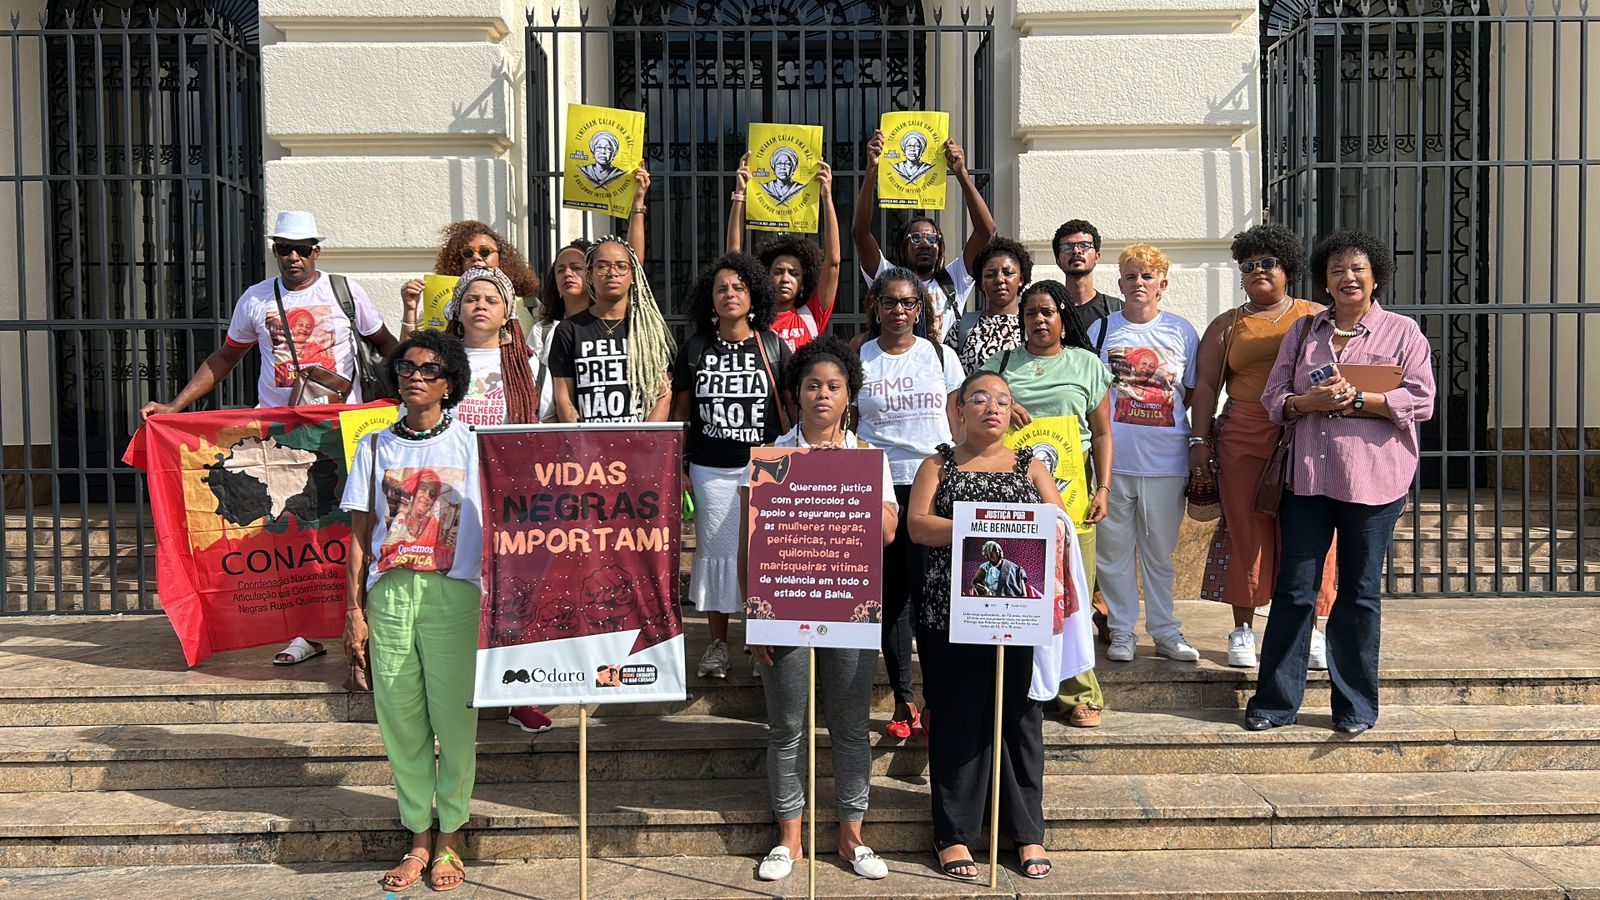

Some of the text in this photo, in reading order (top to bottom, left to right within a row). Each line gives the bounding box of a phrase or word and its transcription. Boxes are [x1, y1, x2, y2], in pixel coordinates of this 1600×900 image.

[705, 353, 756, 371] PELE
[576, 359, 628, 384] PRET
[697, 372, 767, 394] PRETA
[578, 386, 625, 418] NÃO
[879, 393, 943, 413] JUNTAS
[459, 405, 504, 414] MULHERES
[699, 398, 765, 428] NÃO É
[459, 414, 504, 425] NEGRAS
[534, 461, 627, 487] VIDAS
[789, 482, 872, 494] Queremos justiça
[503, 491, 659, 524] NEGRAS
[771, 496, 860, 506] com protocolos de
[760, 509, 871, 520] apoio e segurança para
[984, 510, 1011, 520] JUSTIÇA
[764, 522, 866, 534] as mulheres negras,
[971, 521, 1039, 534] MÃE BERNADETE!
[493, 527, 670, 556] IMPORTAM!
[767, 534, 863, 547] periféricas, rurais,
[221, 540, 348, 576] CONAQ
[779, 548, 850, 559] quilombolas e
[760, 561, 869, 573] marisqueiras vítimas
[291, 571, 326, 583] Nacional
[328, 570, 338, 578] de
[759, 575, 771, 584] de
[774, 575, 815, 585] violência
[837, 577, 859, 586] todo
[862, 578, 869, 586] o
[233, 590, 276, 603] Articulação
[292, 581, 345, 595] Comunidades
[774, 589, 854, 599] estado da Bahia.
[239, 604, 268, 615] Negras
[296, 593, 344, 606] Quilombolas
[531, 667, 585, 683] Odara
